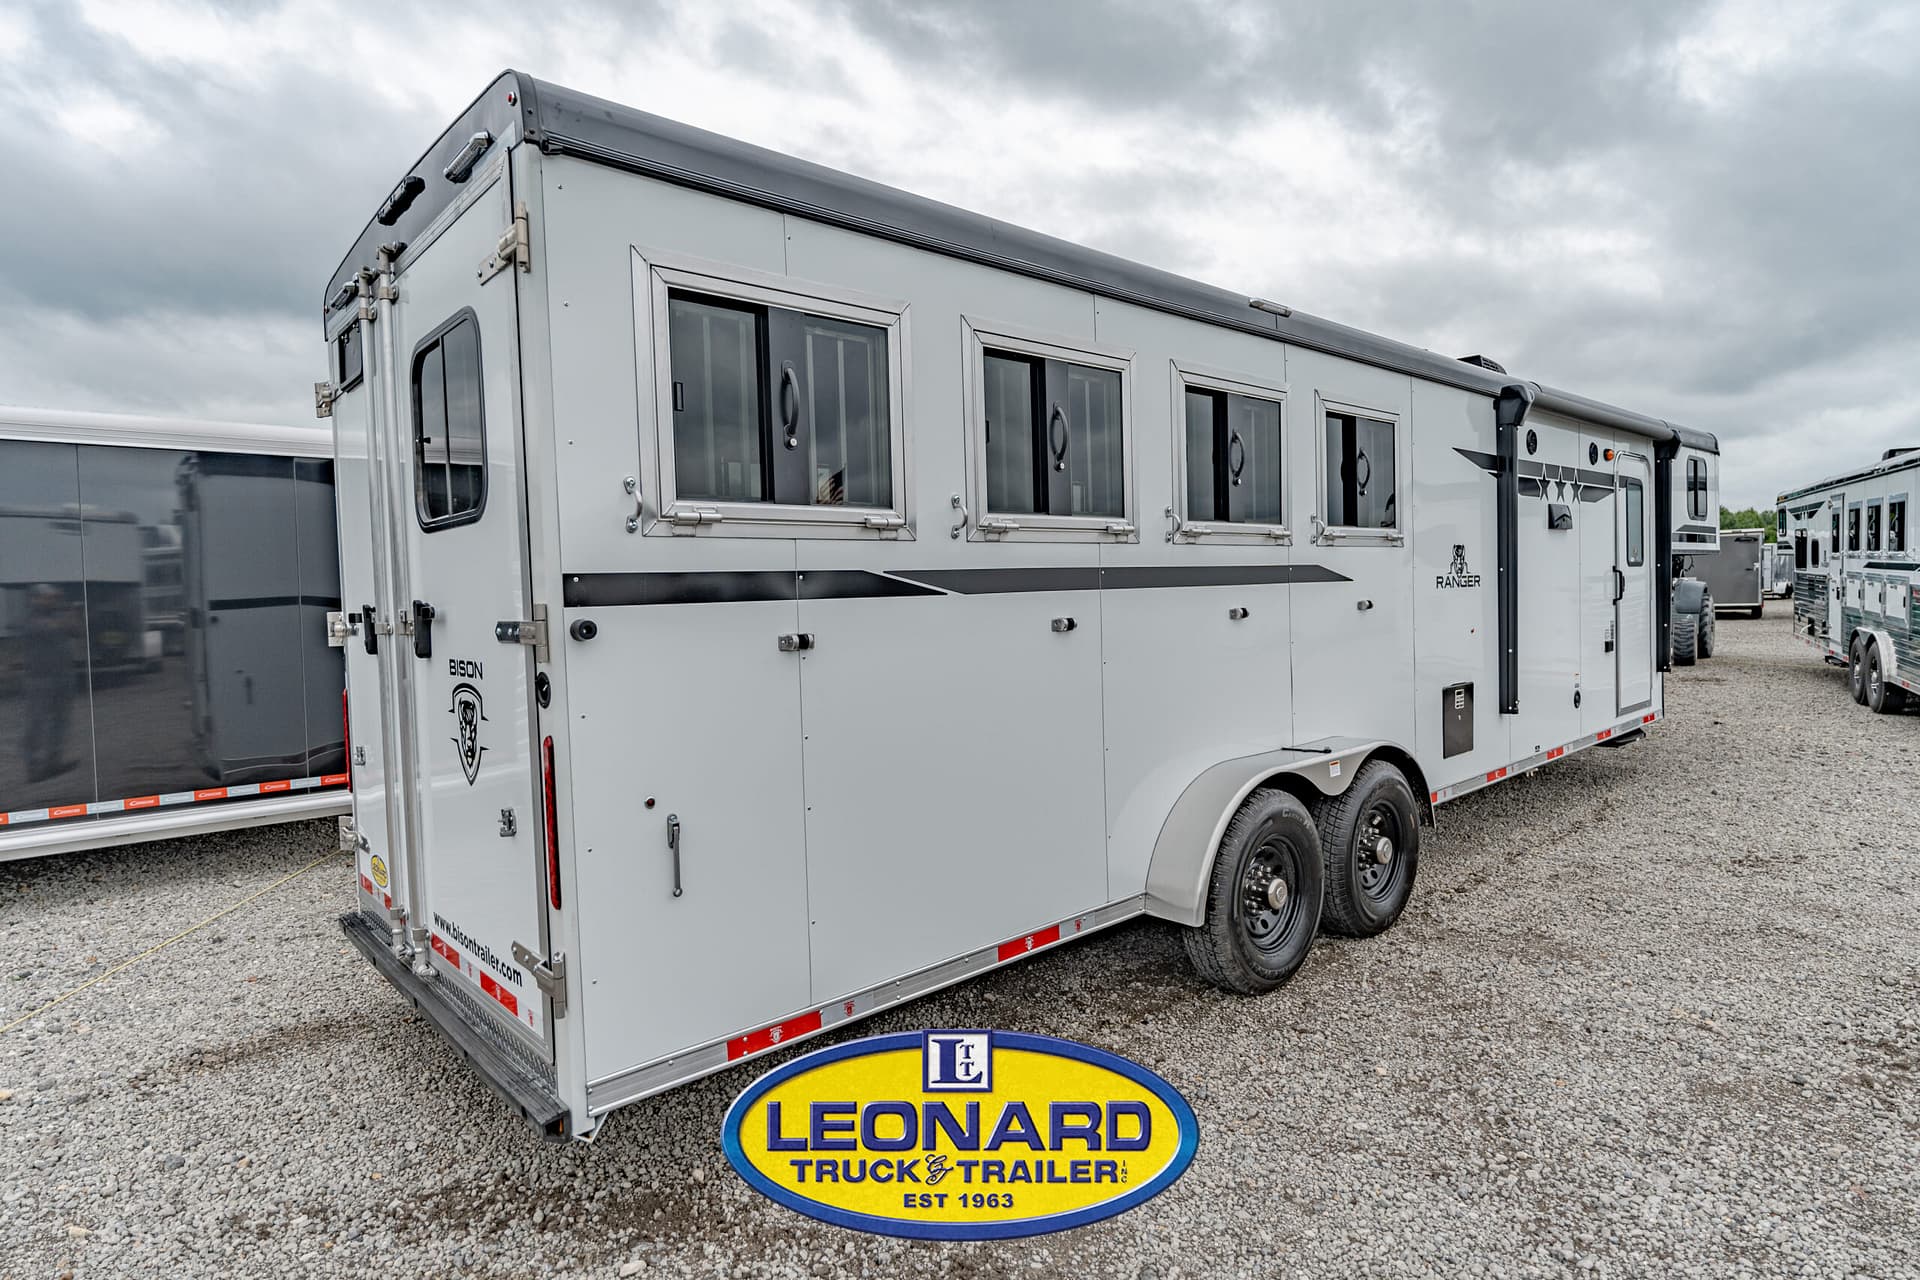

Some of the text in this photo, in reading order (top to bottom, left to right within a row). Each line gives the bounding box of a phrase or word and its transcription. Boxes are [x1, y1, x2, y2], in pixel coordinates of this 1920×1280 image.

[1436, 575, 1481, 589] RANGER
[449, 658, 483, 680] BISON
[433, 911, 523, 987] www.bisontrailer.com
